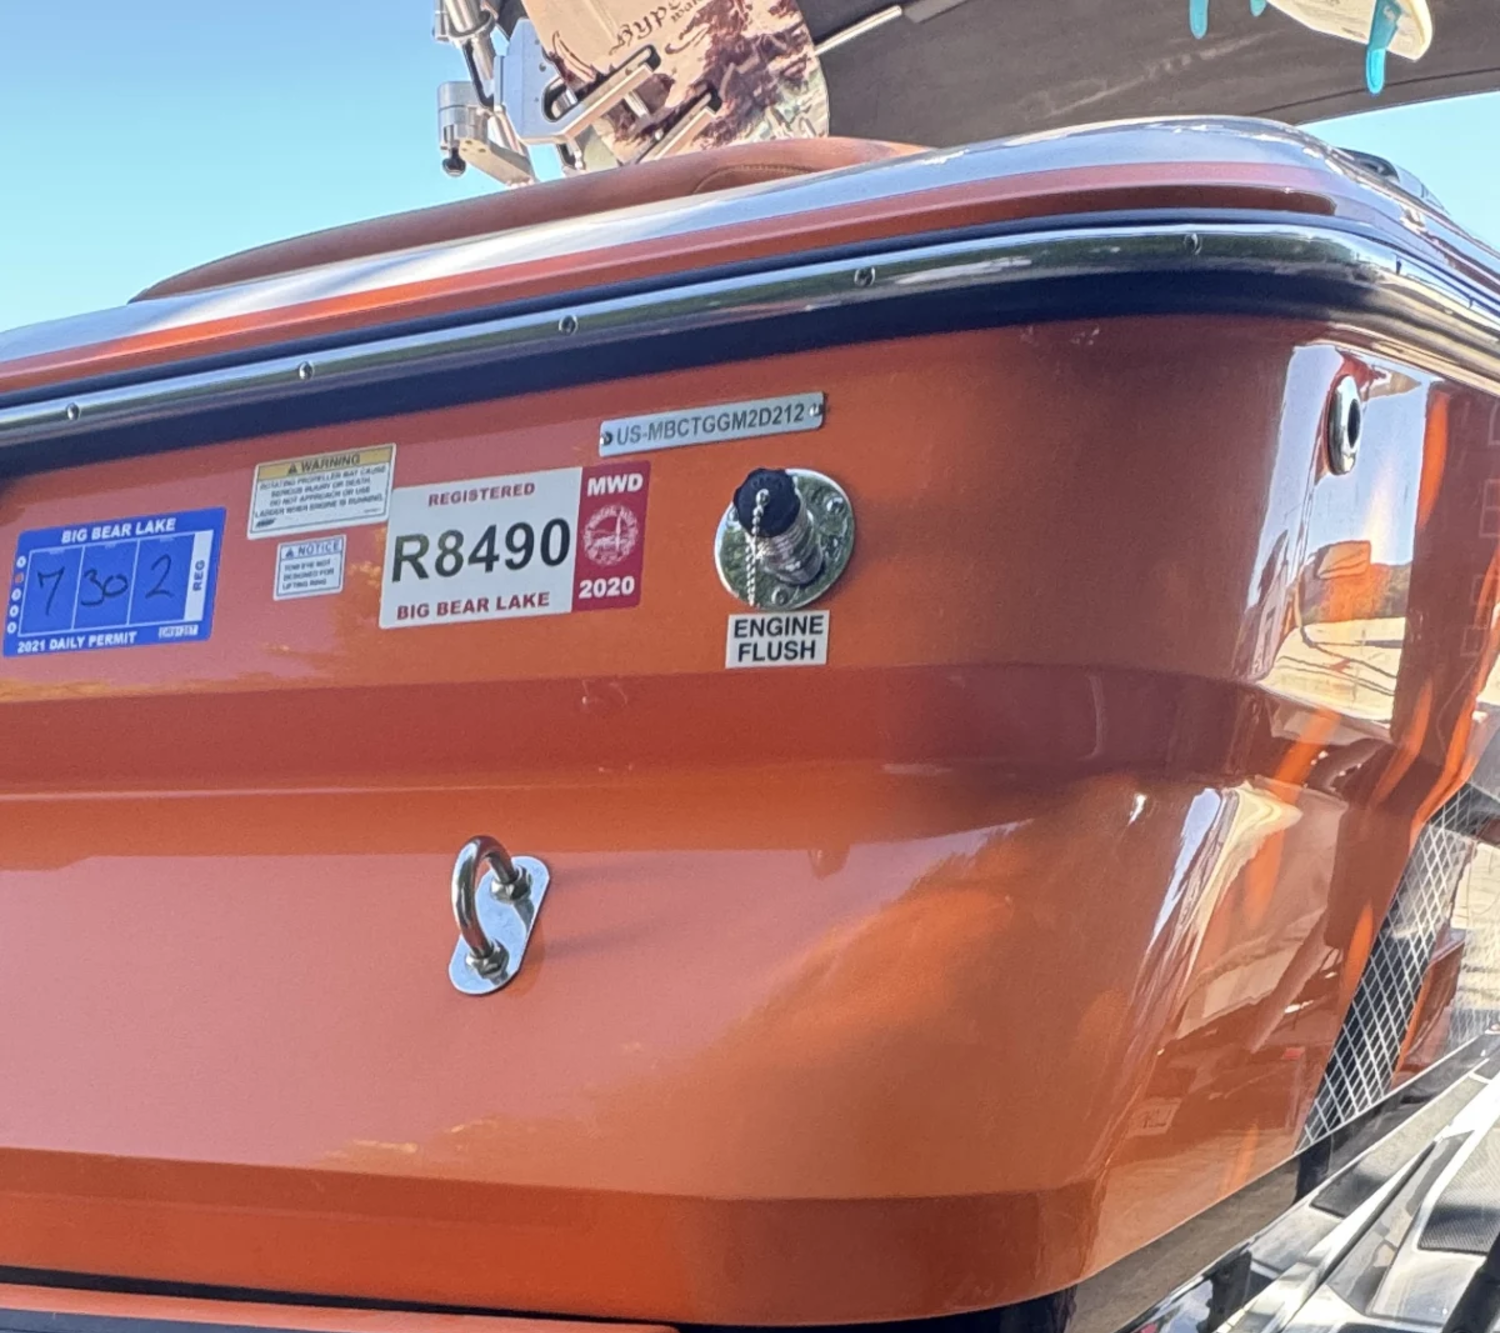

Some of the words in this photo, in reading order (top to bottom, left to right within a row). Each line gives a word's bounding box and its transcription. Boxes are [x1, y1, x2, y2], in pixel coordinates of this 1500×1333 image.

[301, 453, 360, 473] WARNING
[428, 482, 536, 508] REGISTERED
[587, 473, 644, 497] MWD
[61, 530, 88, 545] BIG
[91, 522, 132, 541] BEAR
[136, 517, 177, 536] LAKE
[298, 539, 340, 555] NOTICE
[392, 517, 571, 583] R8490
[145, 553, 174, 600] 2
[192, 560, 206, 592] REG
[579, 576, 635, 599] 2020
[397, 603, 430, 621] BIG
[436, 596, 490, 617] BEAR
[496, 591, 550, 611] LAKE
[734, 615, 824, 639] ENGINE
[17, 640, 46, 654] 2021
[49, 635, 88, 651] DAILY
[88, 631, 138, 649] PERMIT
[738, 640, 816, 663] FLUSH
